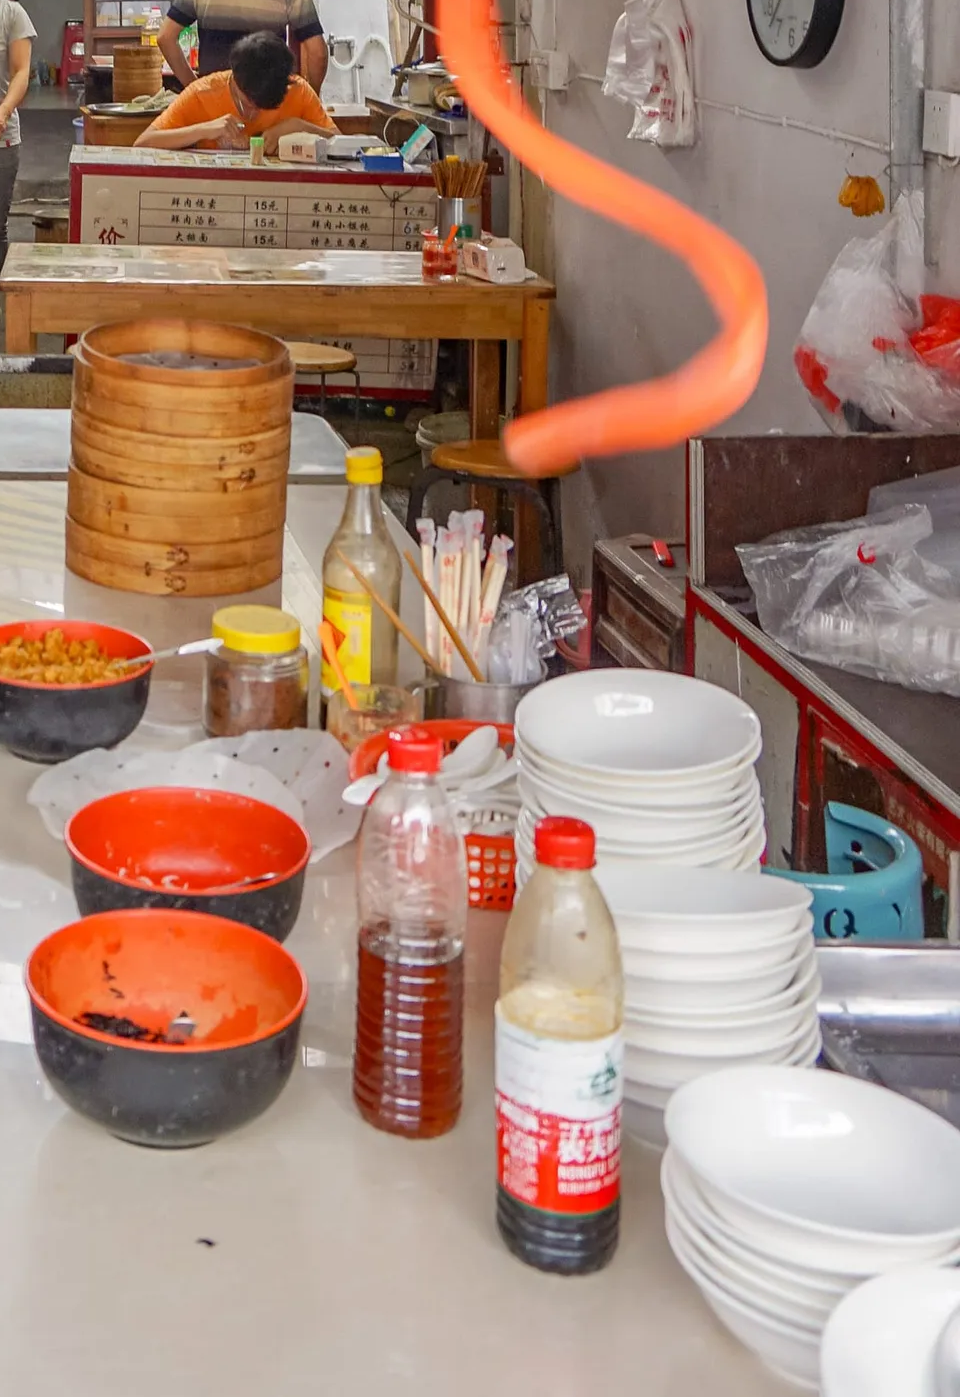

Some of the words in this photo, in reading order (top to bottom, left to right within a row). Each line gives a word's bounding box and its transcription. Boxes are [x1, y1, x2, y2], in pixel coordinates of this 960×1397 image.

[776, 18, 784, 38] 7
[788, 28, 795, 48] 6
[254, 201, 279, 212] 15元
[253, 218, 278, 229] 15元
[253, 235, 278, 246] 15元
